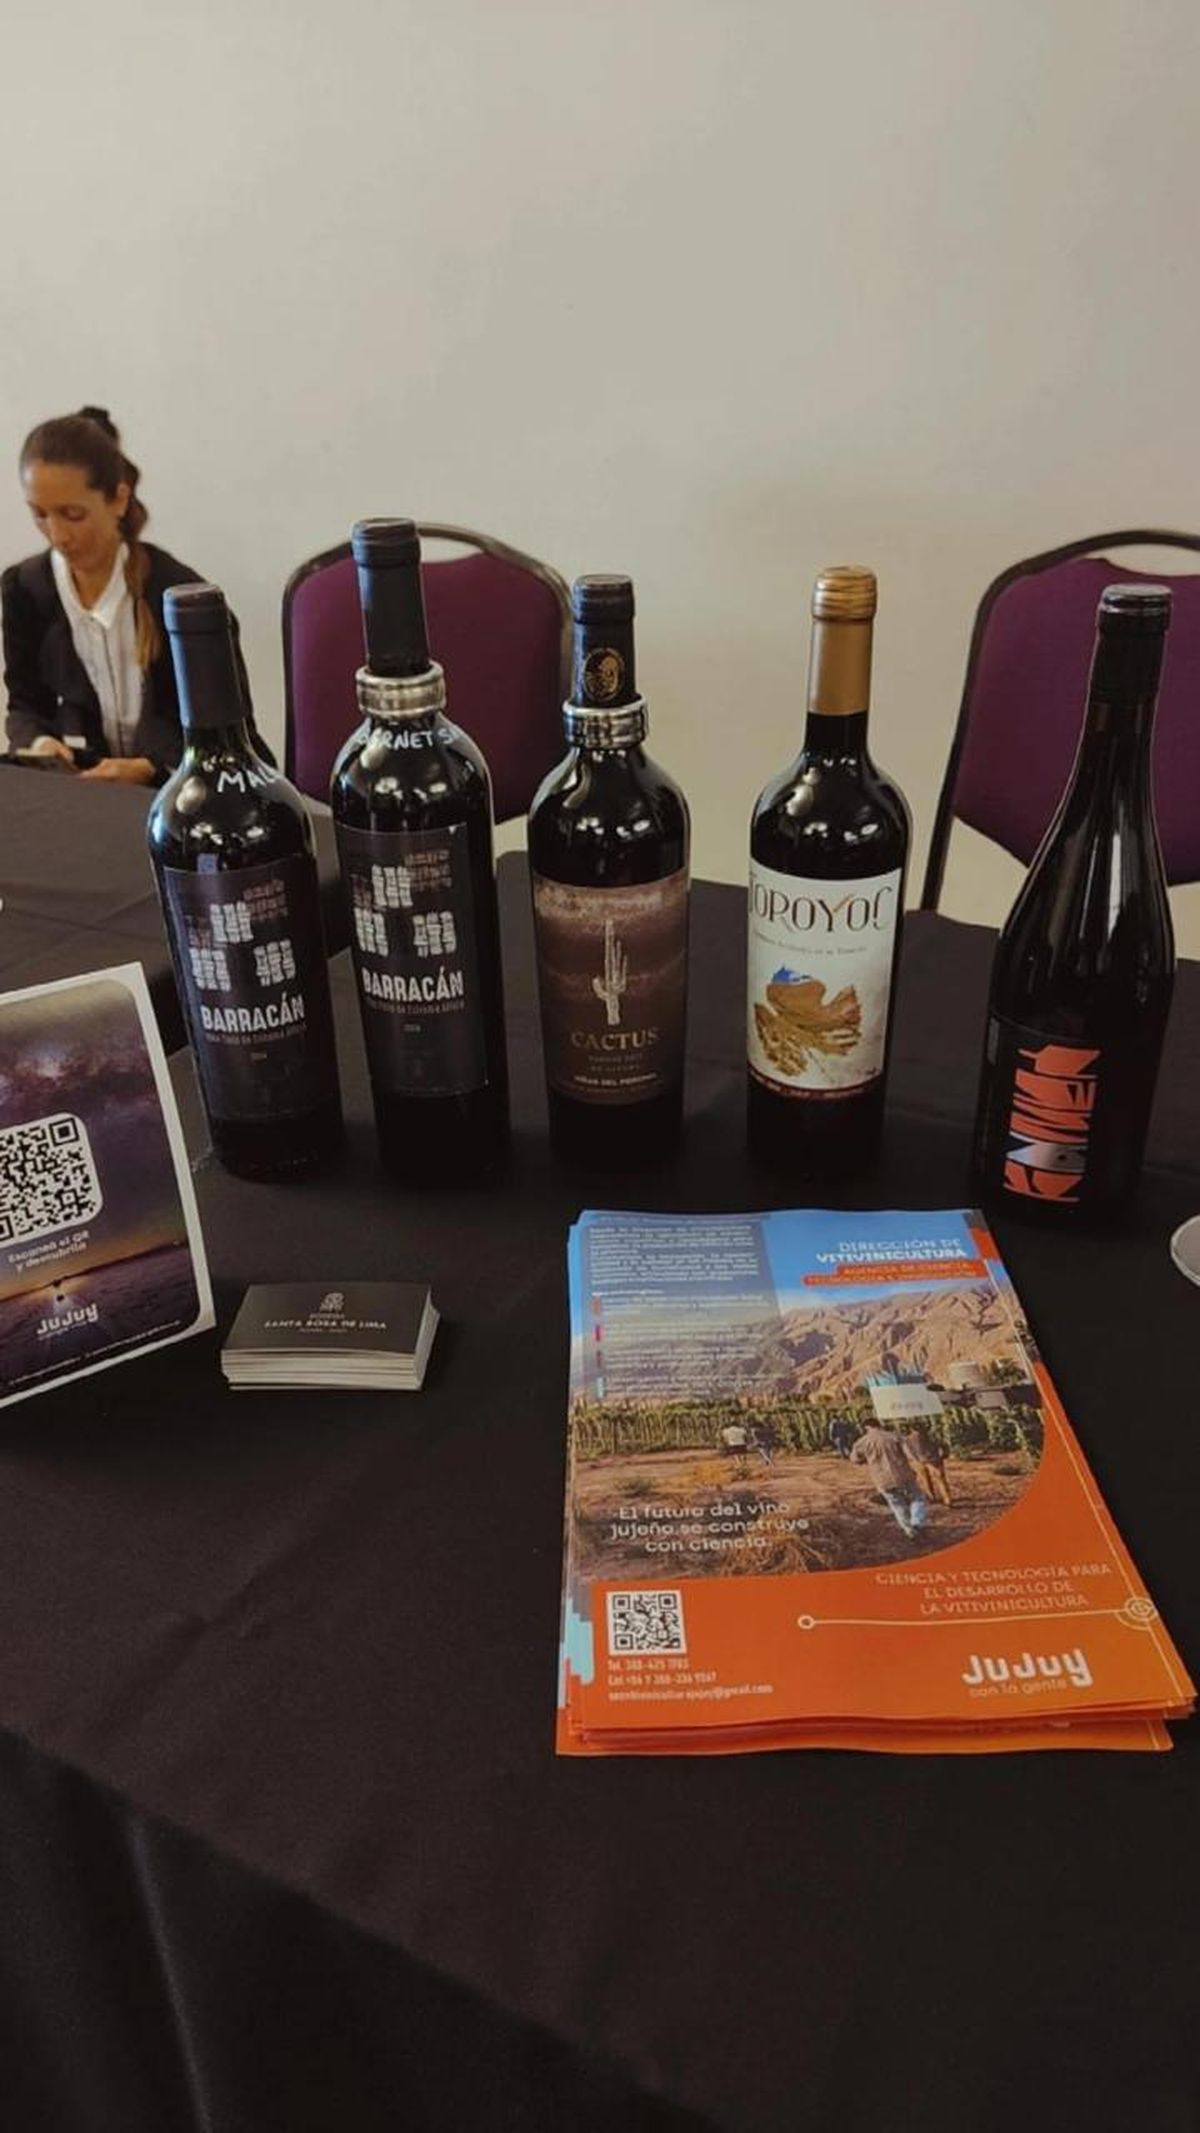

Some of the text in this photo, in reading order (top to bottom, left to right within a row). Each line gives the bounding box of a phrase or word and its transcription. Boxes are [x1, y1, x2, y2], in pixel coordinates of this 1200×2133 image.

[361, 965, 464, 1002] BARRACÁN
[201, 991, 304, 1033] BARRACÁN
[571, 1027, 659, 1051] CACTUS
[815, 1248, 968, 1264] VITIVINICULTURA
[839, 1239, 936, 1253] DIRECCIÓN
[643, 1505, 705, 1520] futuro
[709, 1500, 743, 1517] del
[747, 1502, 790, 1515] vino
[610, 1521, 674, 1541] jujeño
[708, 1517, 810, 1533] construye
[644, 1541, 684, 1553] con
[876, 1571, 948, 1586] CIENCIA
[1071, 1563, 1113, 1577] PARA
[923, 1581, 1074, 1600] EL DESARROLLO DE
[919, 1593, 1090, 1615] LA VITIVINICULTURA
[1022, 1677, 1068, 1695] gente
